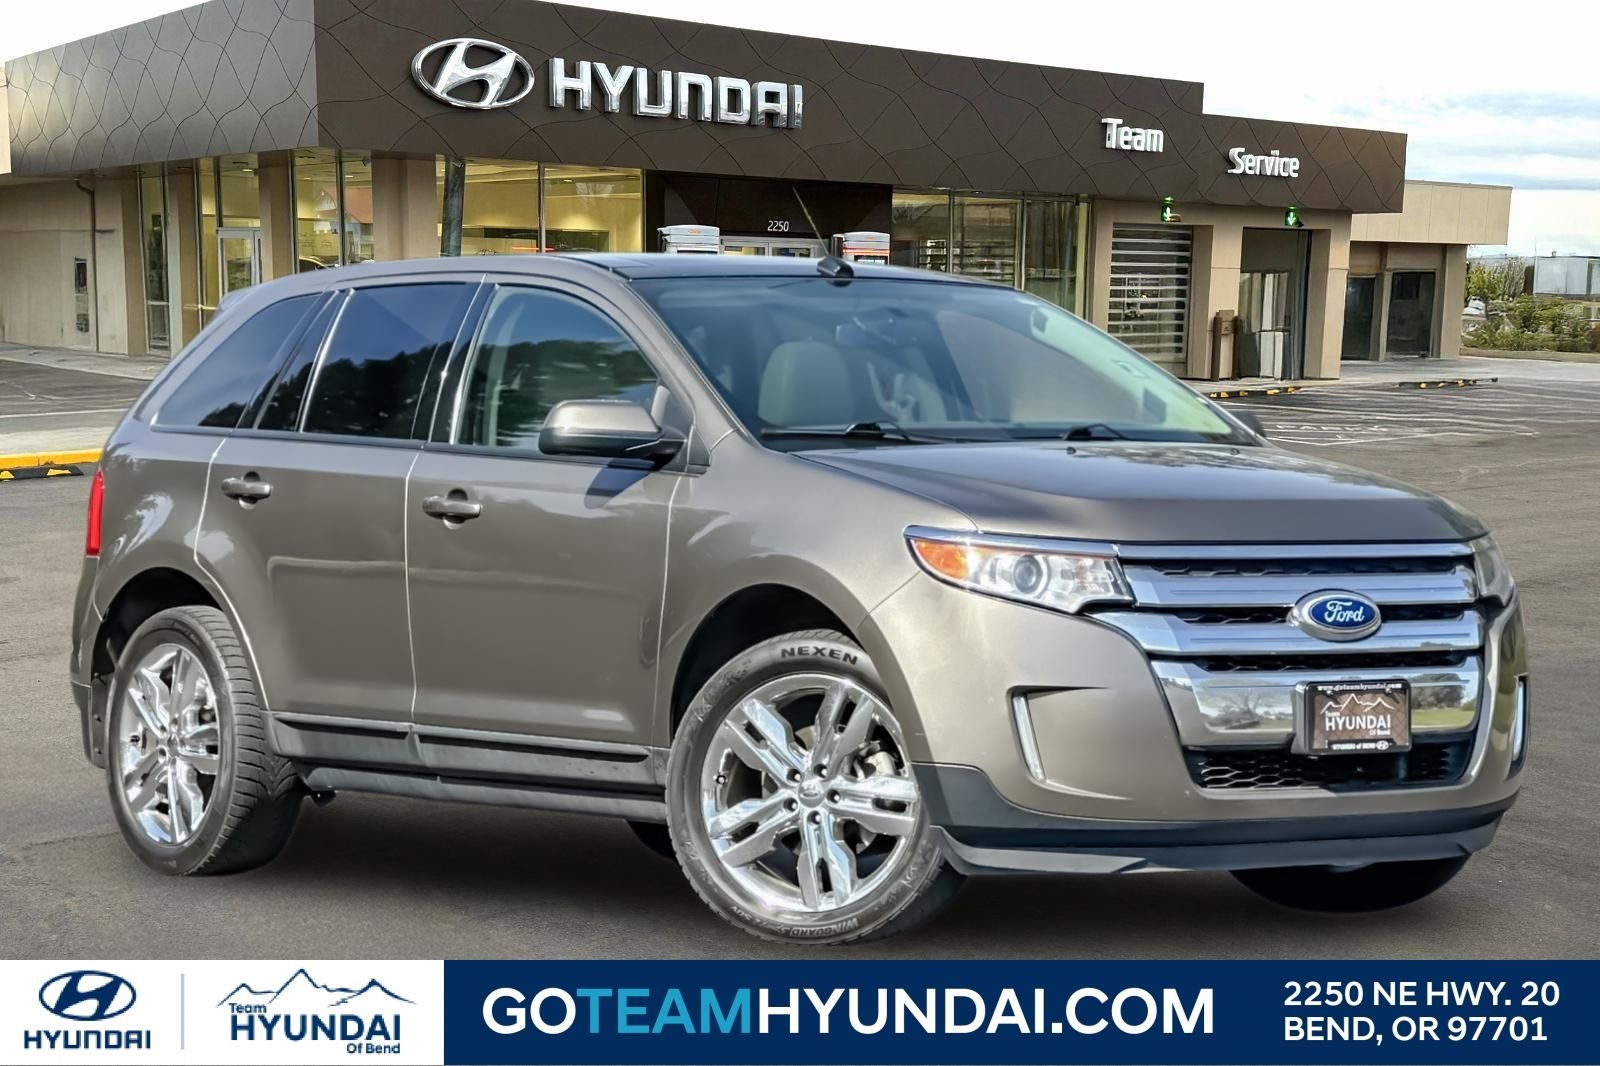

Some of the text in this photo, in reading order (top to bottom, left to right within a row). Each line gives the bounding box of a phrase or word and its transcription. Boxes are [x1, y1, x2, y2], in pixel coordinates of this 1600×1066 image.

[548, 57, 803, 129] HYUNDAI
[1101, 117, 1164, 153] Team
[1227, 147, 1300, 178] Service
[767, 220, 790, 232] 2250
[1324, 600, 1366, 623] Ford
[781, 646, 859, 665] NEXEN
[1325, 714, 1392, 731] HYUNDAI
